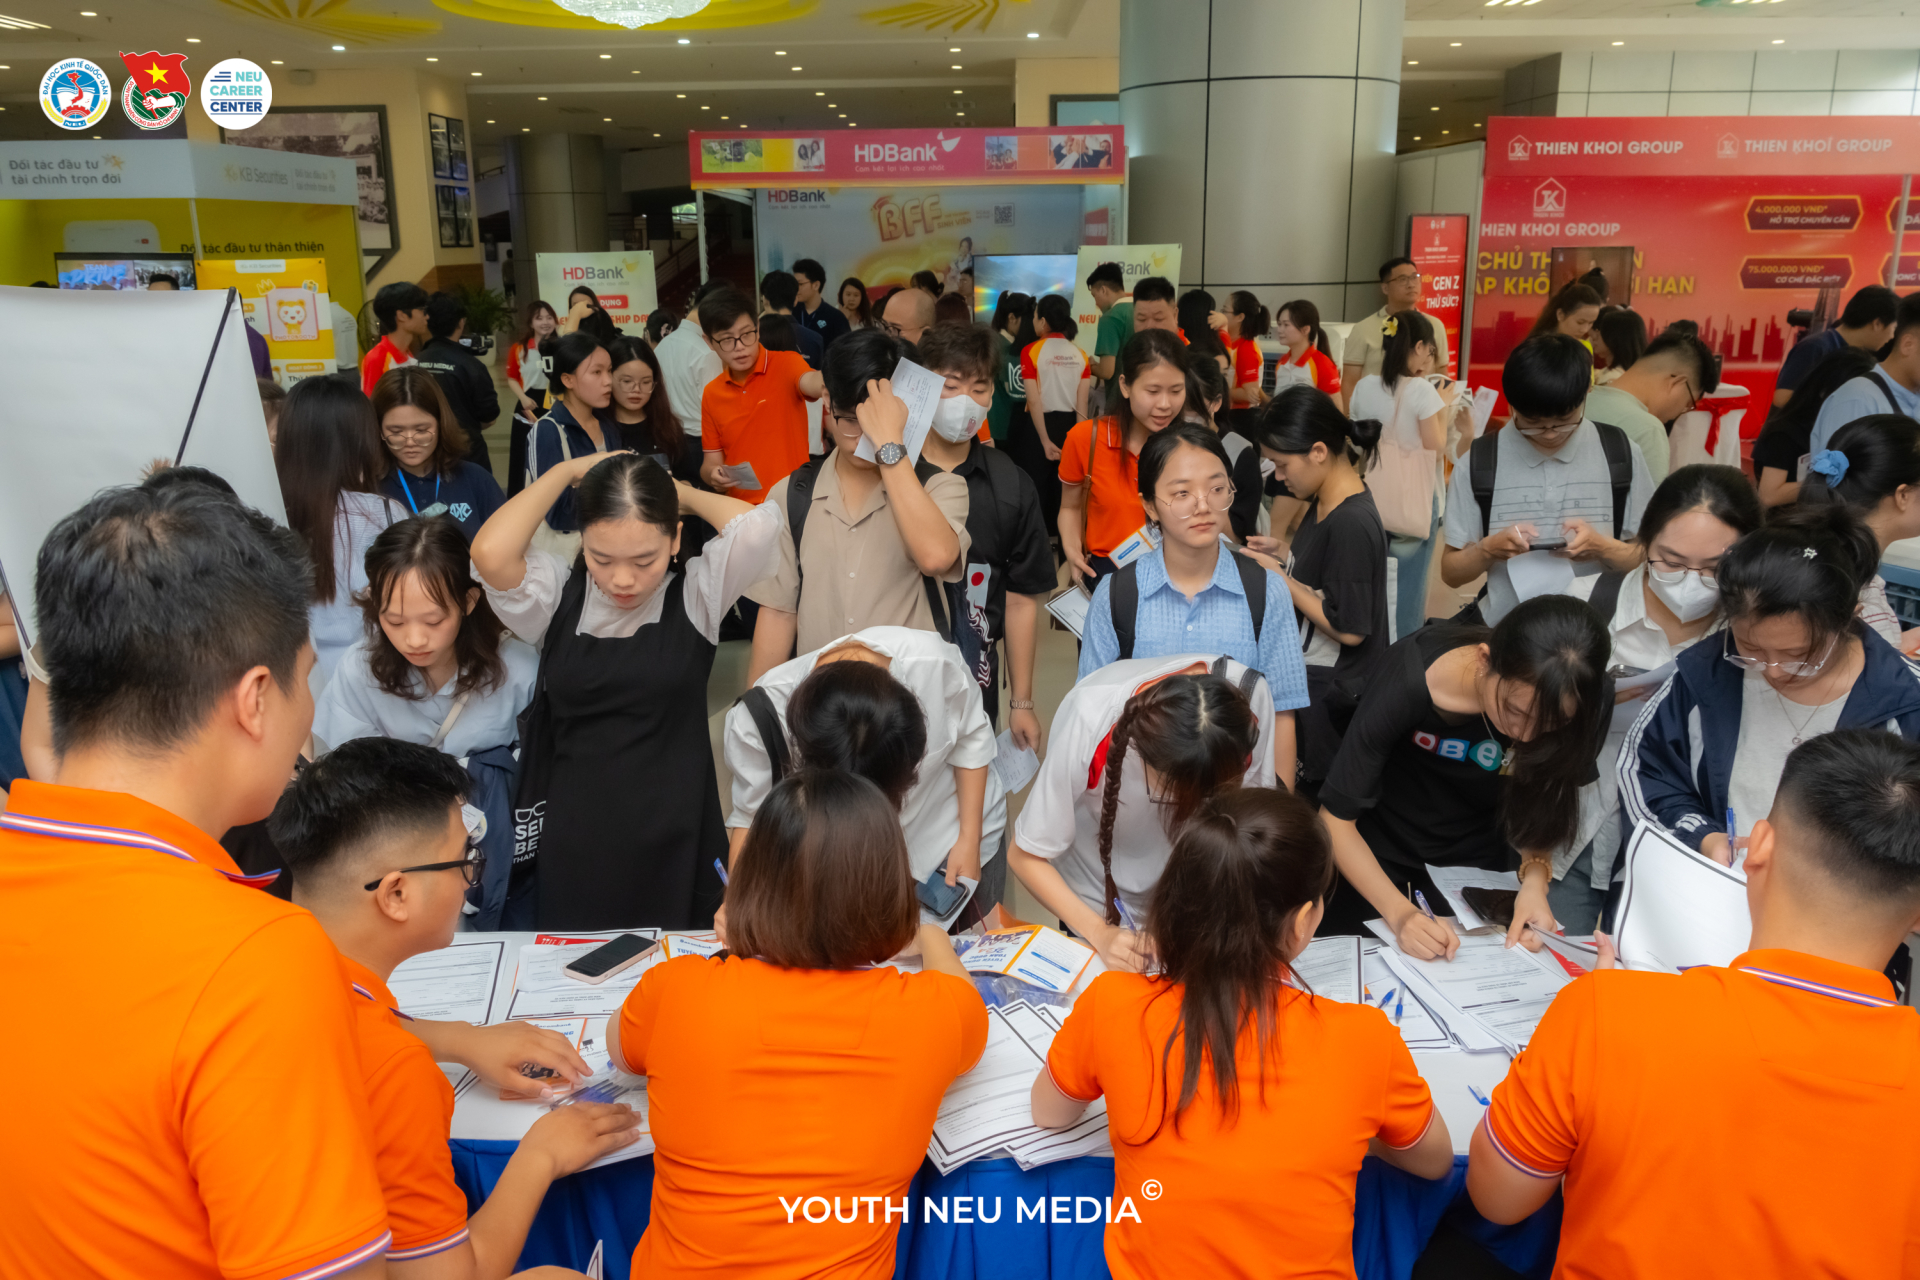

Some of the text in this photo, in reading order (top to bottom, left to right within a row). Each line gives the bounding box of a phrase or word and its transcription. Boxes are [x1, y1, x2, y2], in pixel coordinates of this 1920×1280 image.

[854, 143, 938, 163] HDBank
[1535, 140, 1684, 155] THIEN KHOI GROUP
[1745, 139, 1788, 153] THIEN
[1836, 139, 1892, 153] GROUP
[34, 159, 54, 170] tác
[58, 158, 82, 170] đầu
[85, 159, 99, 170] tư
[11, 173, 122, 186] tài chính trọn đời
[240, 166, 288, 185] KB Securities
[767, 189, 826, 203] HDBank
[1755, 205, 1801, 214] 4.000.000
[877, 193, 942, 243] BFF
[937, 220, 954, 229] SINH
[955, 217, 972, 226] VIÊN
[1481, 222, 1621, 237] HIEN KHOI GROUP
[181, 241, 325, 254] Đố tác đầu tư thân thiện
[1478, 244, 1523, 270] CHỦ
[562, 266, 624, 280] HDBank
[1749, 265, 1798, 274] 75.000.000
[1433, 275, 1452, 291] GEN
[1453, 275, 1460, 290] Z
[1503, 272, 1550, 295] KHÔ
[1647, 275, 1695, 299] HẠN
[1426, 293, 1441, 309] THỬ
[1078, 314, 1097, 324] NEU
[419, 361, 455, 371] NEU MEDIA
[514, 836, 541, 856] BE
[513, 851, 536, 864] THAN
